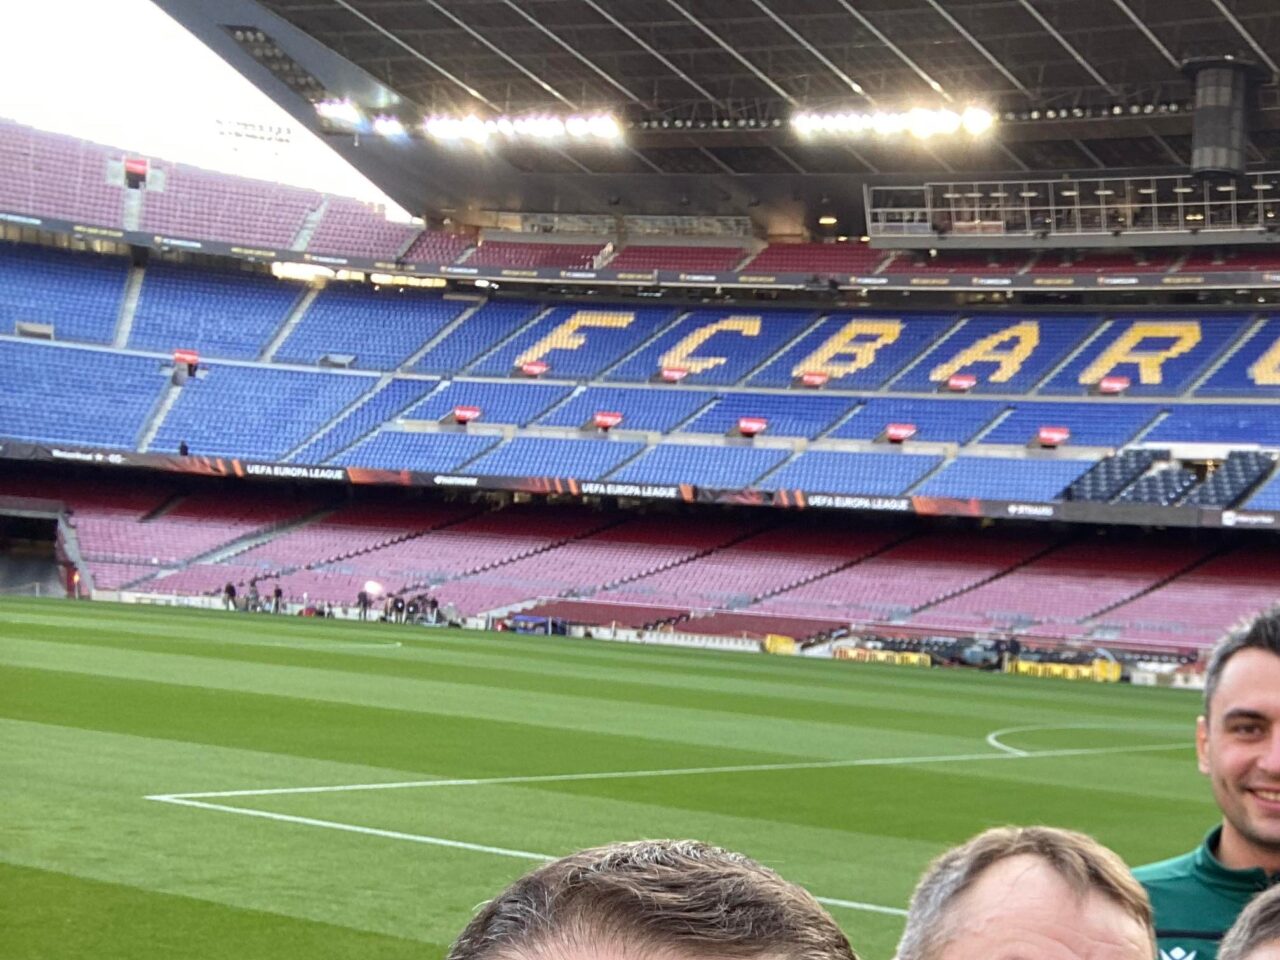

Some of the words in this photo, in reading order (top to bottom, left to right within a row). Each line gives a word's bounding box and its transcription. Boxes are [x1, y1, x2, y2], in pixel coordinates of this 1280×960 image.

[273, 466, 308, 477] EUROPA
[309, 468, 344, 480] LEAGUE
[641, 486, 677, 498] LEAGUE
